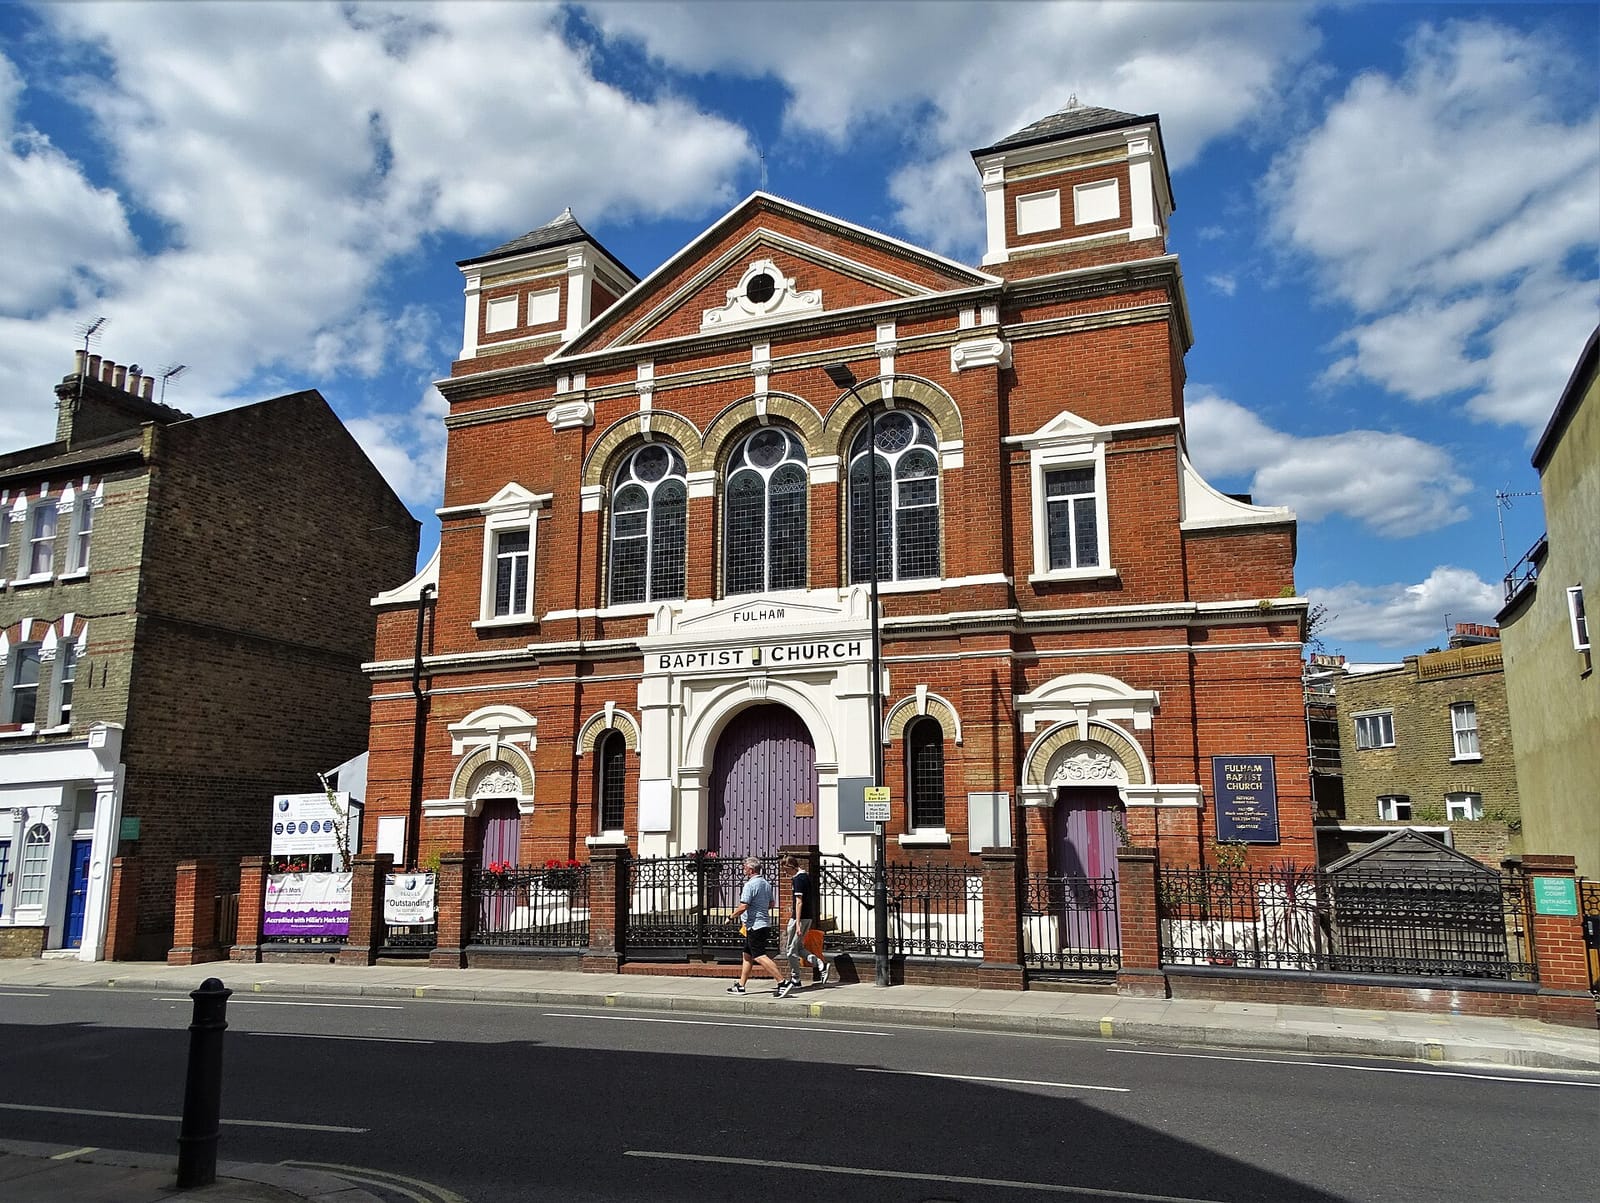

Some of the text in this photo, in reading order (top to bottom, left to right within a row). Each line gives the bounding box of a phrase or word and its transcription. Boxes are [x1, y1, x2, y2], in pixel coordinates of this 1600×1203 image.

[733, 608, 785, 622] FULHAM
[659, 641, 862, 669] BAPTIST CHURCH
[1225, 773, 1262, 781] BAPTIST
[1226, 782, 1263, 790] CHURCH
[265, 916, 293, 924] Accredited
[294, 916, 305, 924] with
[323, 916, 336, 924] Mark
[336, 916, 349, 924] 2021
